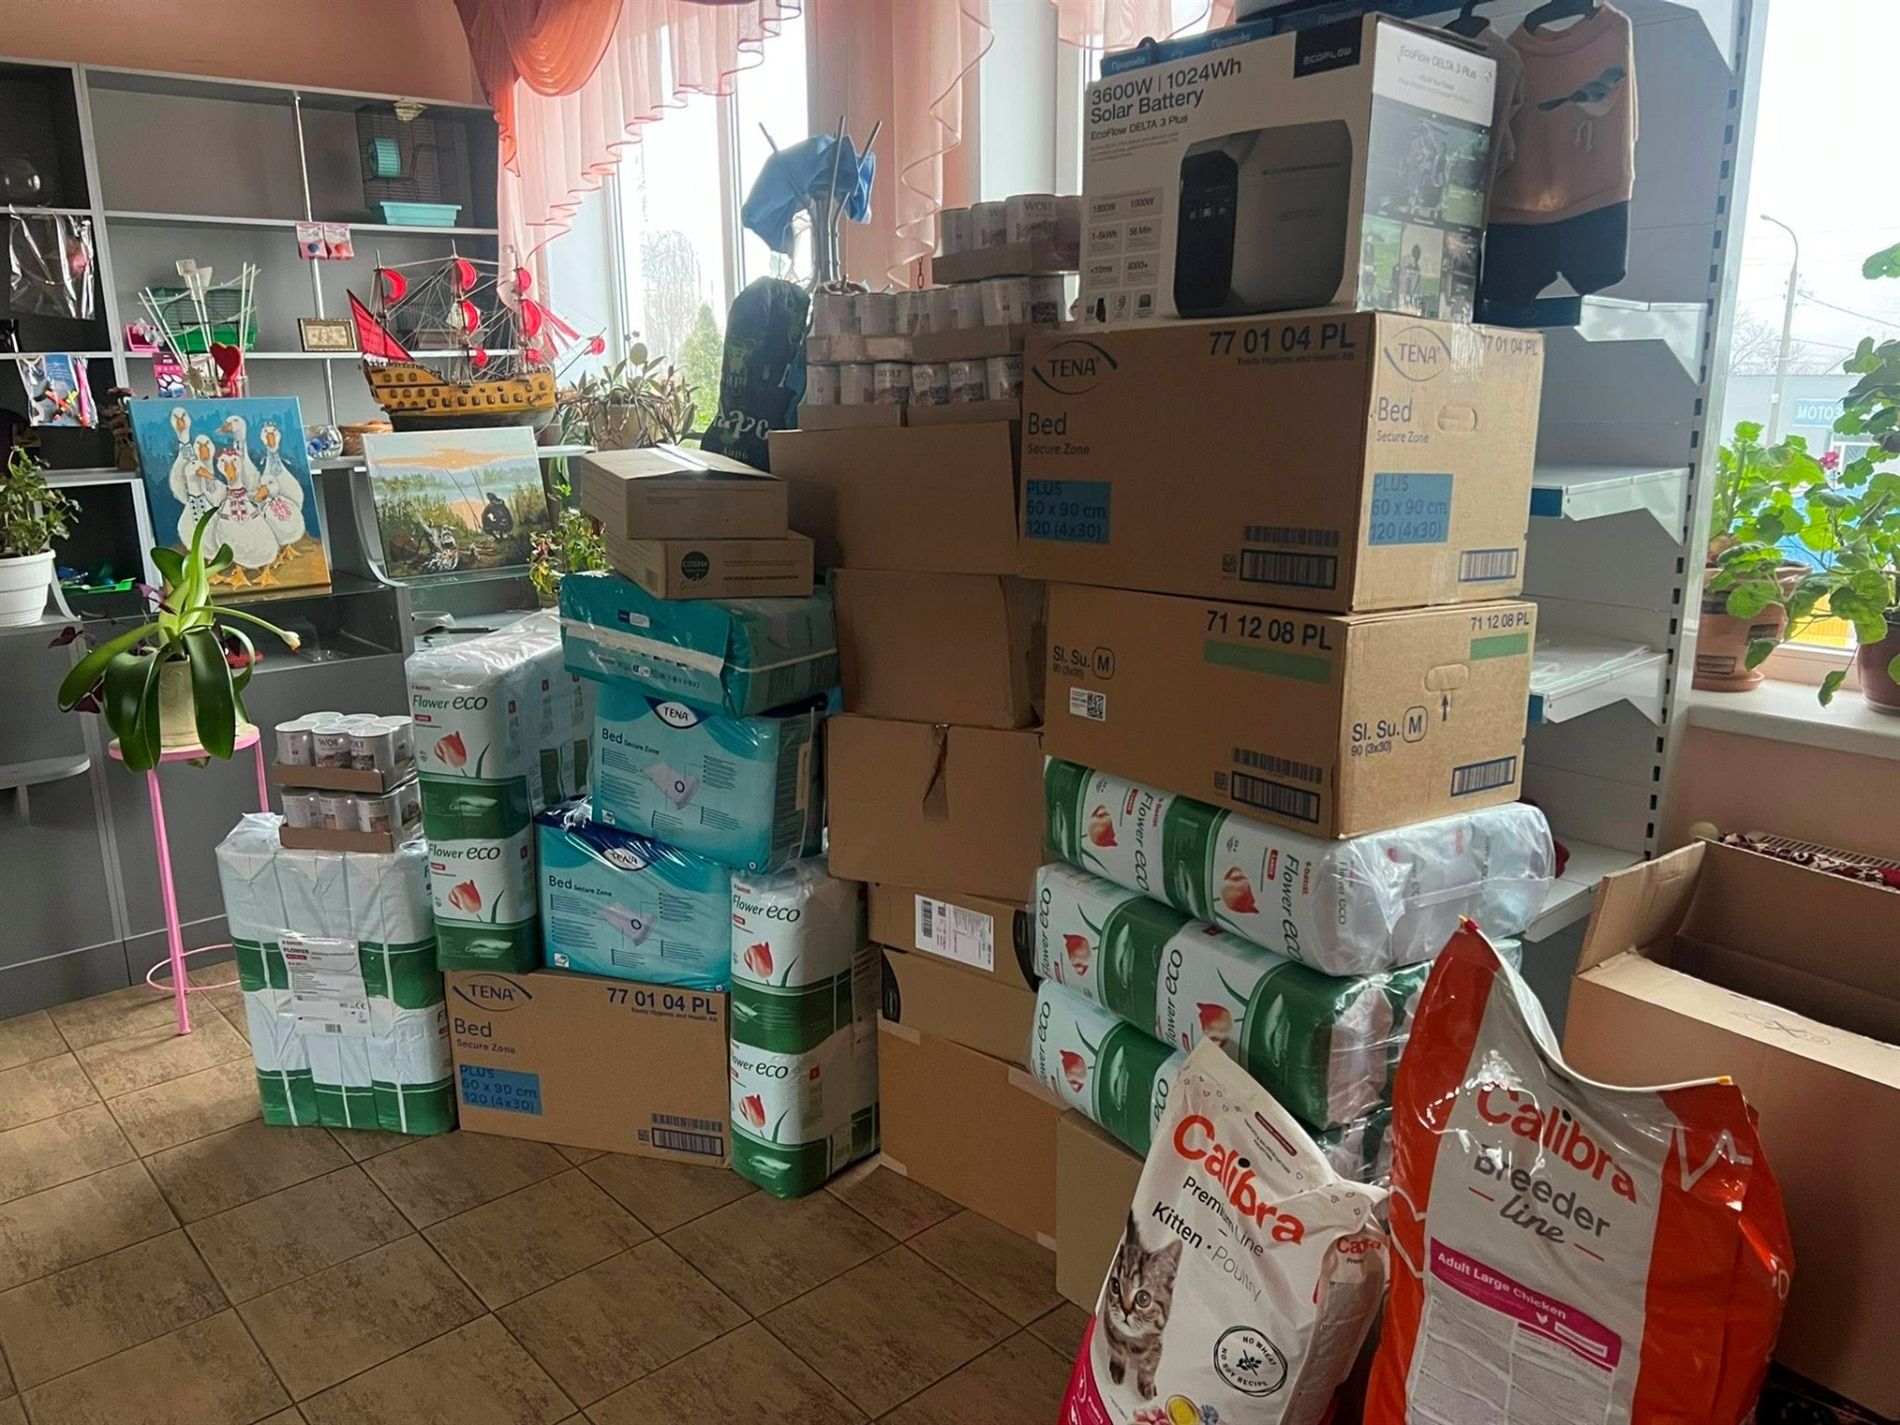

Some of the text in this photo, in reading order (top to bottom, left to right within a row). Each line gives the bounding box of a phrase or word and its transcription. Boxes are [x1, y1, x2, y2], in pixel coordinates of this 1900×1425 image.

[1091, 58, 1242, 106] 3600W 1024Wh
[1091, 88, 1204, 124] Solar Battery
[1091, 113, 1188, 141] EcoFlow DELTA 3 Plus
[1209, 322, 1355, 355] 77 01 04 PL
[1495, 336, 1508, 351] 01
[1511, 338, 1523, 354] 04
[1525, 340, 1539, 356] PL
[1398, 343, 1437, 364] TENA
[1049, 358, 1097, 377] TENA
[1378, 397, 1412, 422] Bed
[1028, 412, 1067, 435] Bed
[1376, 430, 1430, 444] Secure Zone
[1028, 443, 1090, 455] Secure Zone
[1028, 481, 1062, 496] PLUS
[1374, 475, 1409, 491] PLUS
[1027, 502, 1106, 519] 60 x 90 cm
[1372, 500, 1447, 516] 60 x 90 cm
[1027, 520, 1101, 542] 120 (4x30)
[1371, 521, 1441, 540] 120 (4x30)
[1206, 610, 1332, 651] 71 12 08 PL
[1471, 611, 1530, 631] 71 12 08 PL
[1096, 654, 1109, 672] M
[413, 694, 488, 711] Flower eco
[663, 706, 690, 722] TENA
[602, 728, 623, 744] Bed
[1376, 720, 1400, 739] Su.
[1408, 715, 1423, 734] M
[624, 740, 660, 756] Secure Zone
[1351, 740, 1392, 757] 90 (3x30)
[429, 843, 501, 860] Flower eco
[1135, 792, 1153, 892] Flower eco
[549, 875, 573, 890] Bed
[574, 885, 612, 898] Secure Zone
[733, 895, 801, 922] Flower eco
[1281, 853, 1303, 960] Flower eco
[1041, 888, 1052, 979] Flower eco
[1165, 949, 1183, 996] eco
[468, 984, 515, 1001] TENA
[607, 987, 717, 1015] 77 01 04 PL
[454, 1018, 492, 1038] Bed
[1038, 1002, 1051, 1043] eco
[457, 1038, 516, 1055] Secure Zone
[460, 1065, 495, 1079] PLUS
[756, 1062, 789, 1079] eco
[462, 1078, 538, 1099] 60 x 90 cm
[463, 1092, 534, 1113] 120 (4x30)
[1477, 1083, 1637, 1204] Calibra
[1173, 1114, 1305, 1246] Calibra
[1474, 1144, 1610, 1237] Breeder
[1152, 1201, 1203, 1249] Kitten
[1234, 1225, 1264, 1257] Line
[1438, 1252, 1471, 1275] Adult
[1473, 1268, 1510, 1293] Large
[1513, 1287, 1567, 1320] Chicken
[1242, 1336, 1277, 1366] NO WHEAT
[1221, 1347, 1269, 1387] NO SOY RECIPE
